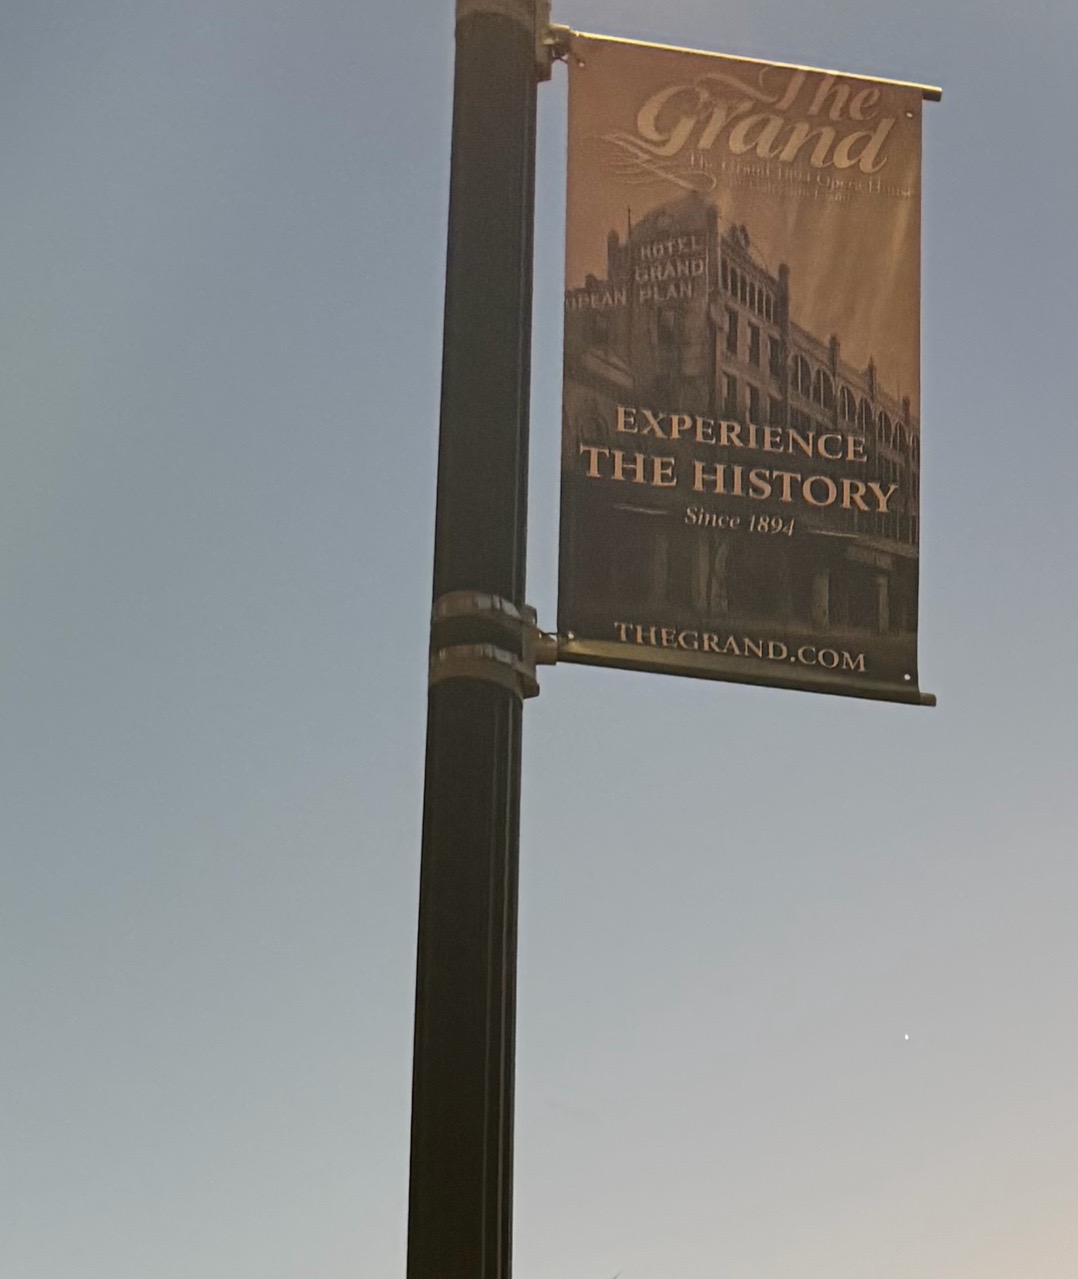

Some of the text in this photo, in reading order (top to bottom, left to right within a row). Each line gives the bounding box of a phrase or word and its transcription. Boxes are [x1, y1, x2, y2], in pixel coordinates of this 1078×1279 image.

[759, 66, 881, 121] The
[636, 72, 896, 174] Grand
[635, 259, 704, 283] GRAND
[640, 235, 703, 260] HOTEL
[640, 280, 693, 304] PLAN
[615, 405, 868, 463] EXPERIENCE
[579, 443, 899, 514] THE HISTORY
[684, 506, 796, 538] Since 1894
[613, 621, 868, 673] THEGRAND.COM
